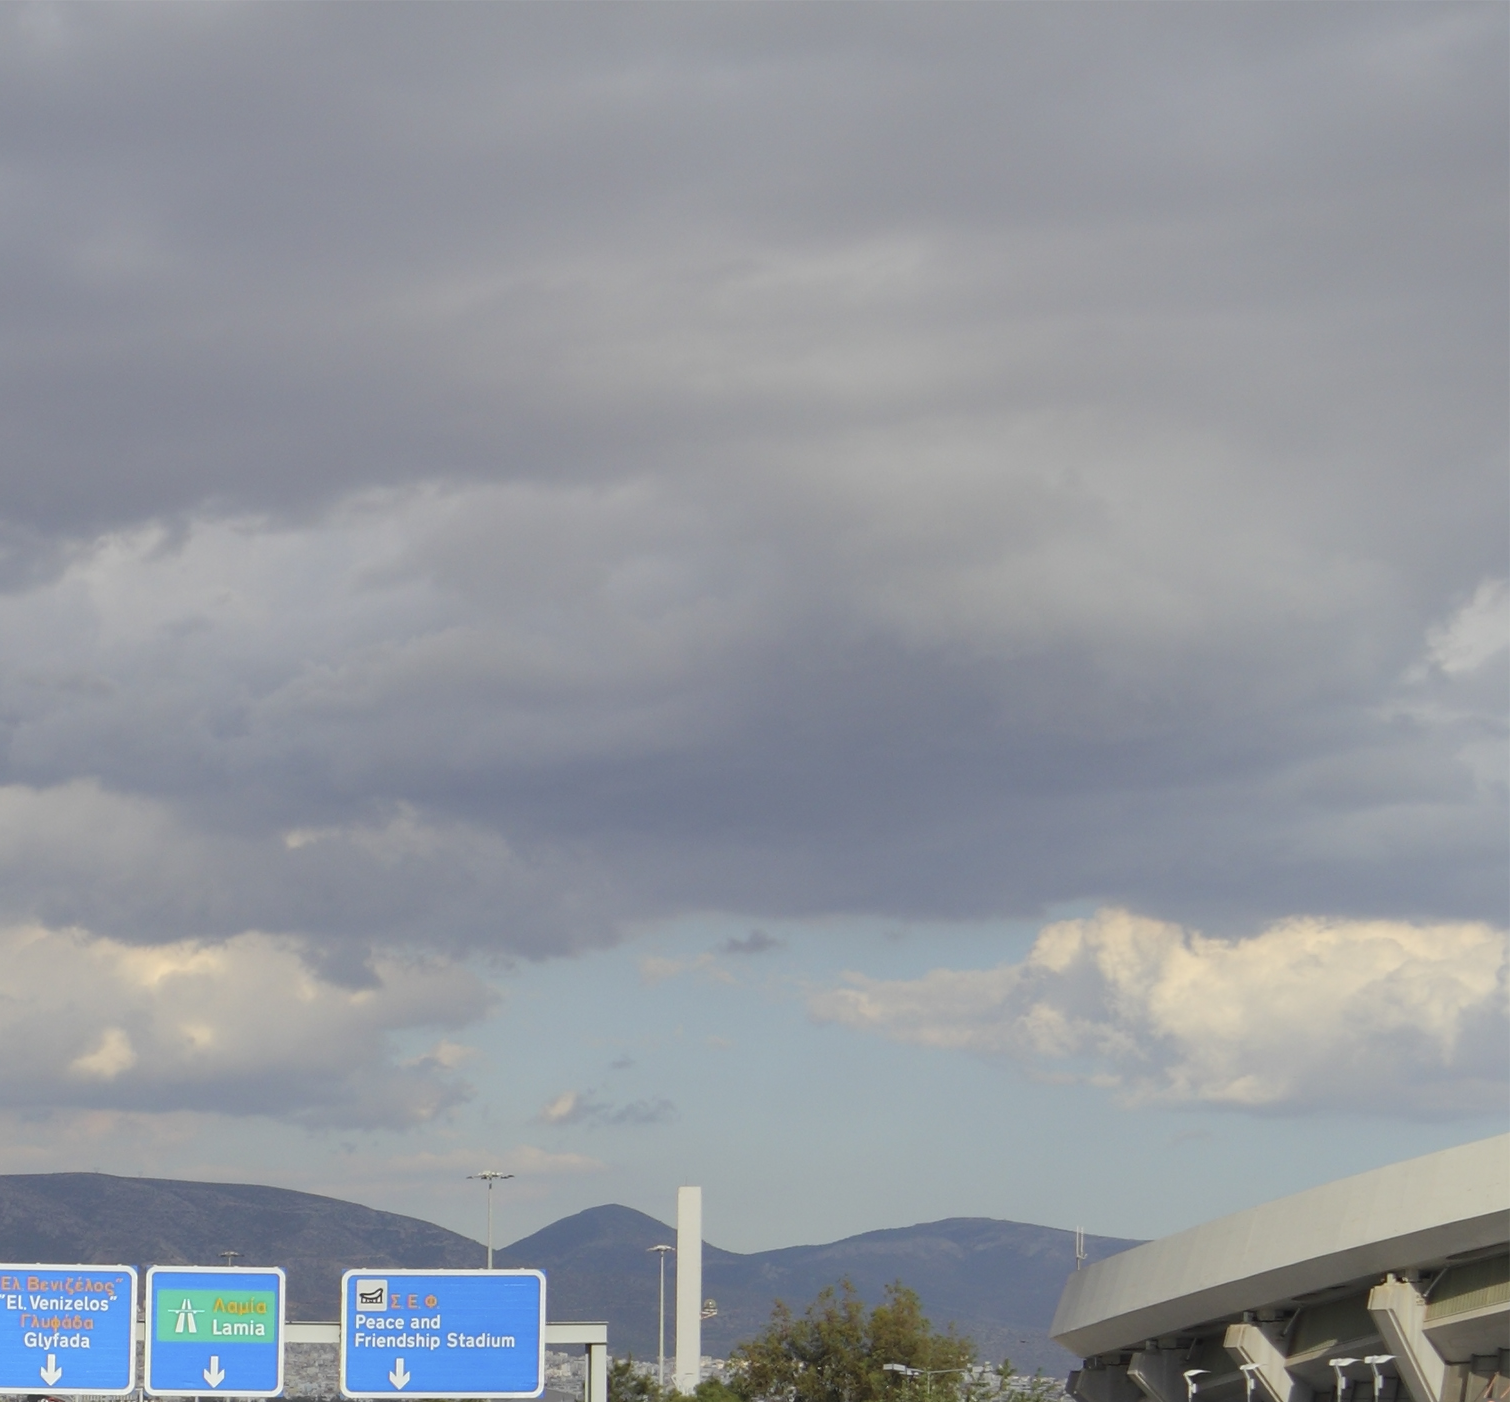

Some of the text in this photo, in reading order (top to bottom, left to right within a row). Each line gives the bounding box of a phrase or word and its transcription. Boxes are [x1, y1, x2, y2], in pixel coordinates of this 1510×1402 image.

[213, 1296, 267, 1315] Λαμία
[20, 1314, 94, 1333] Γλυφάδα
[212, 1319, 265, 1336] Lamia
[355, 1314, 441, 1329] Peace and
[24, 1332, 90, 1350] Glyfada
[354, 1332, 515, 1350] Friendship Stadium
